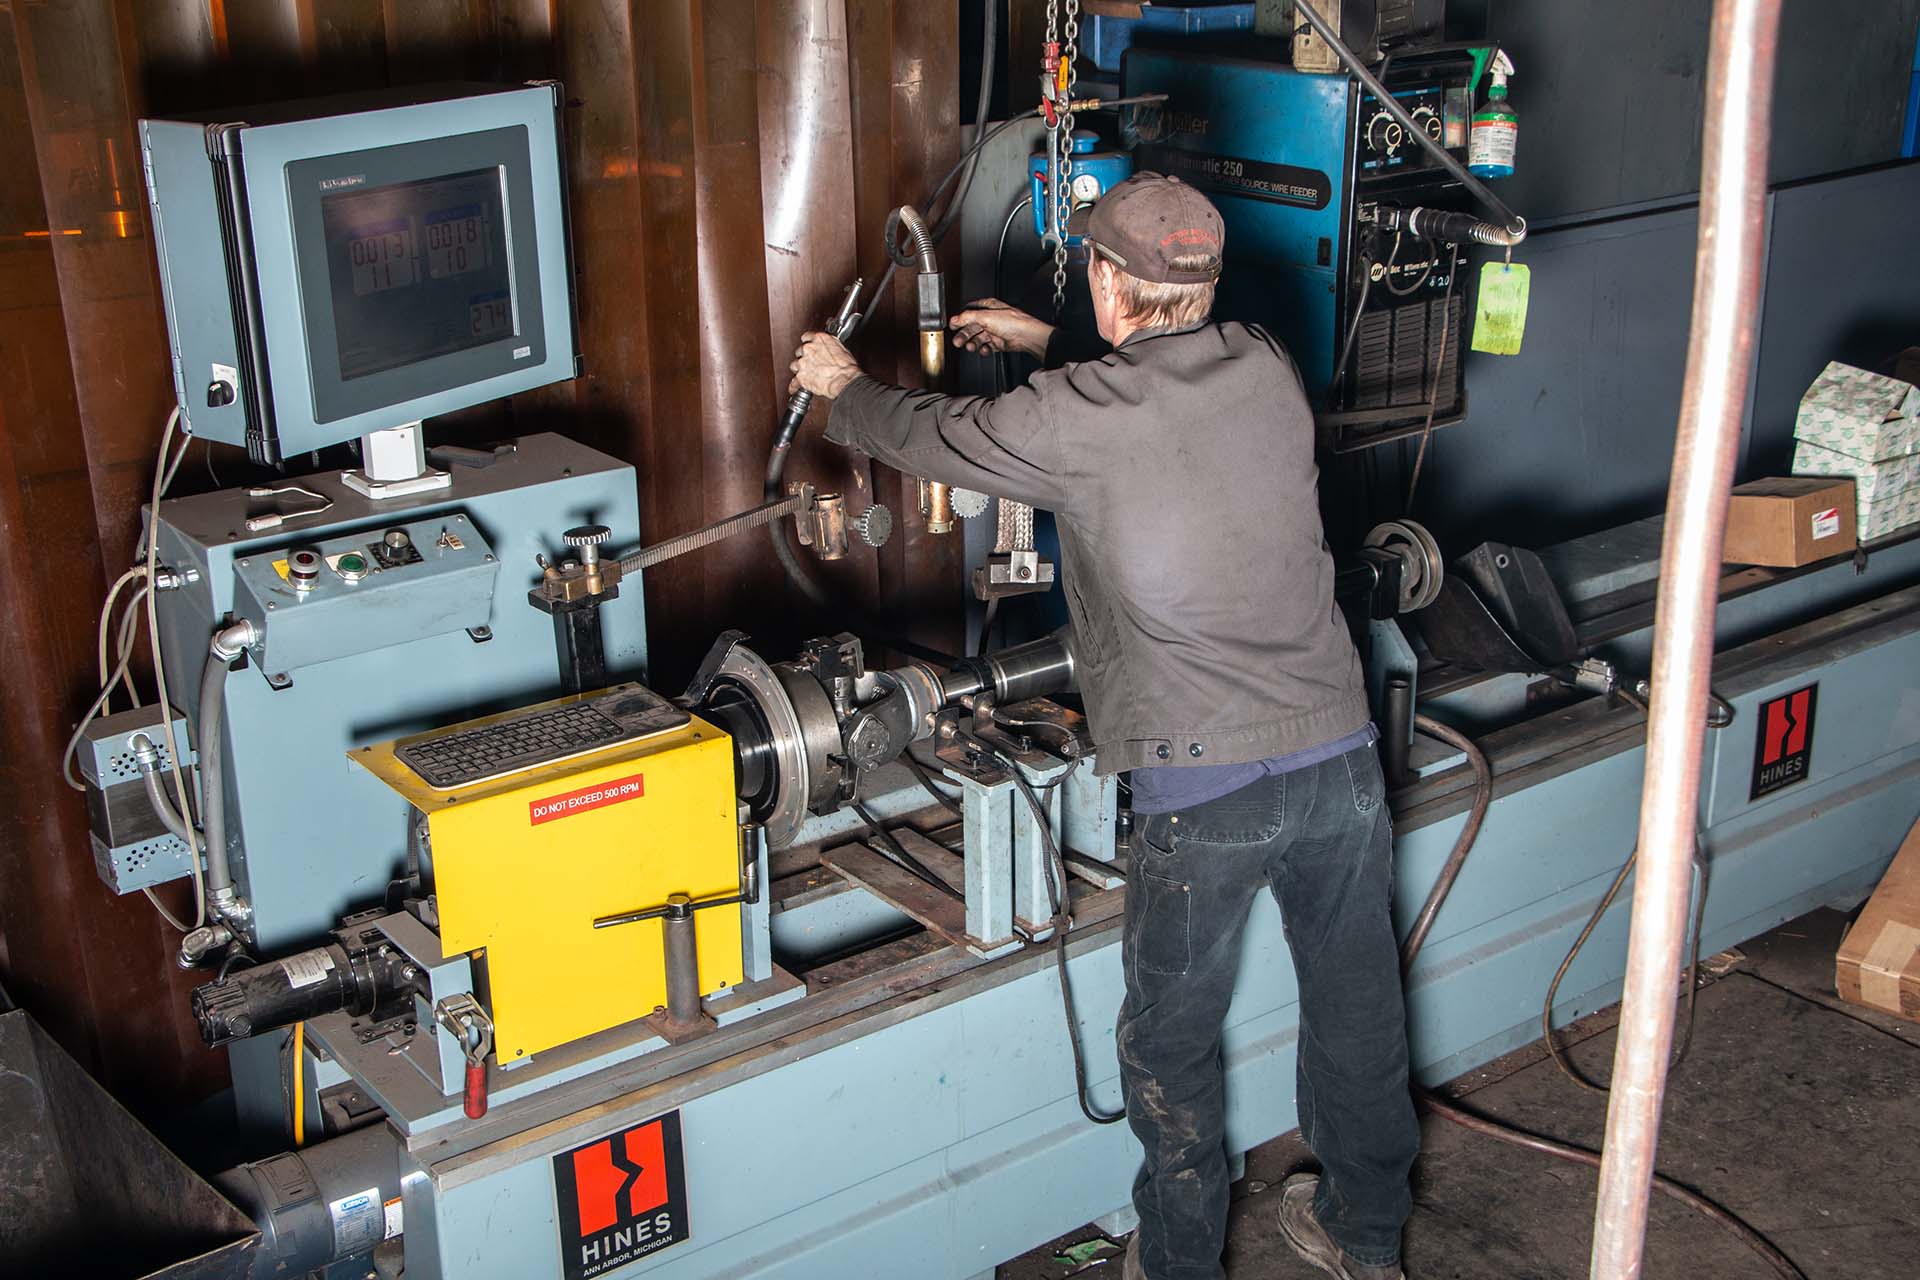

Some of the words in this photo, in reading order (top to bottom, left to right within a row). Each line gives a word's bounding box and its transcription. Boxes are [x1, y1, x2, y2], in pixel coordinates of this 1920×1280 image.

[1223, 160, 1244, 177] 250
[1290, 185, 1318, 198] FEEDER
[472, 304, 507, 332] 274
[1760, 756, 1803, 785] HINES
[533, 805, 548, 818] DO
[549, 800, 568, 814] NOT
[568, 791, 603, 809] EXCEED
[604, 787, 620, 799] 500
[620, 782, 639, 795] RPM
[582, 1212, 672, 1265] HINES
[583, 1264, 601, 1277] ANN
[602, 1252, 633, 1270] ARBOR,
[633, 1234, 673, 1256] MICHIGAN
